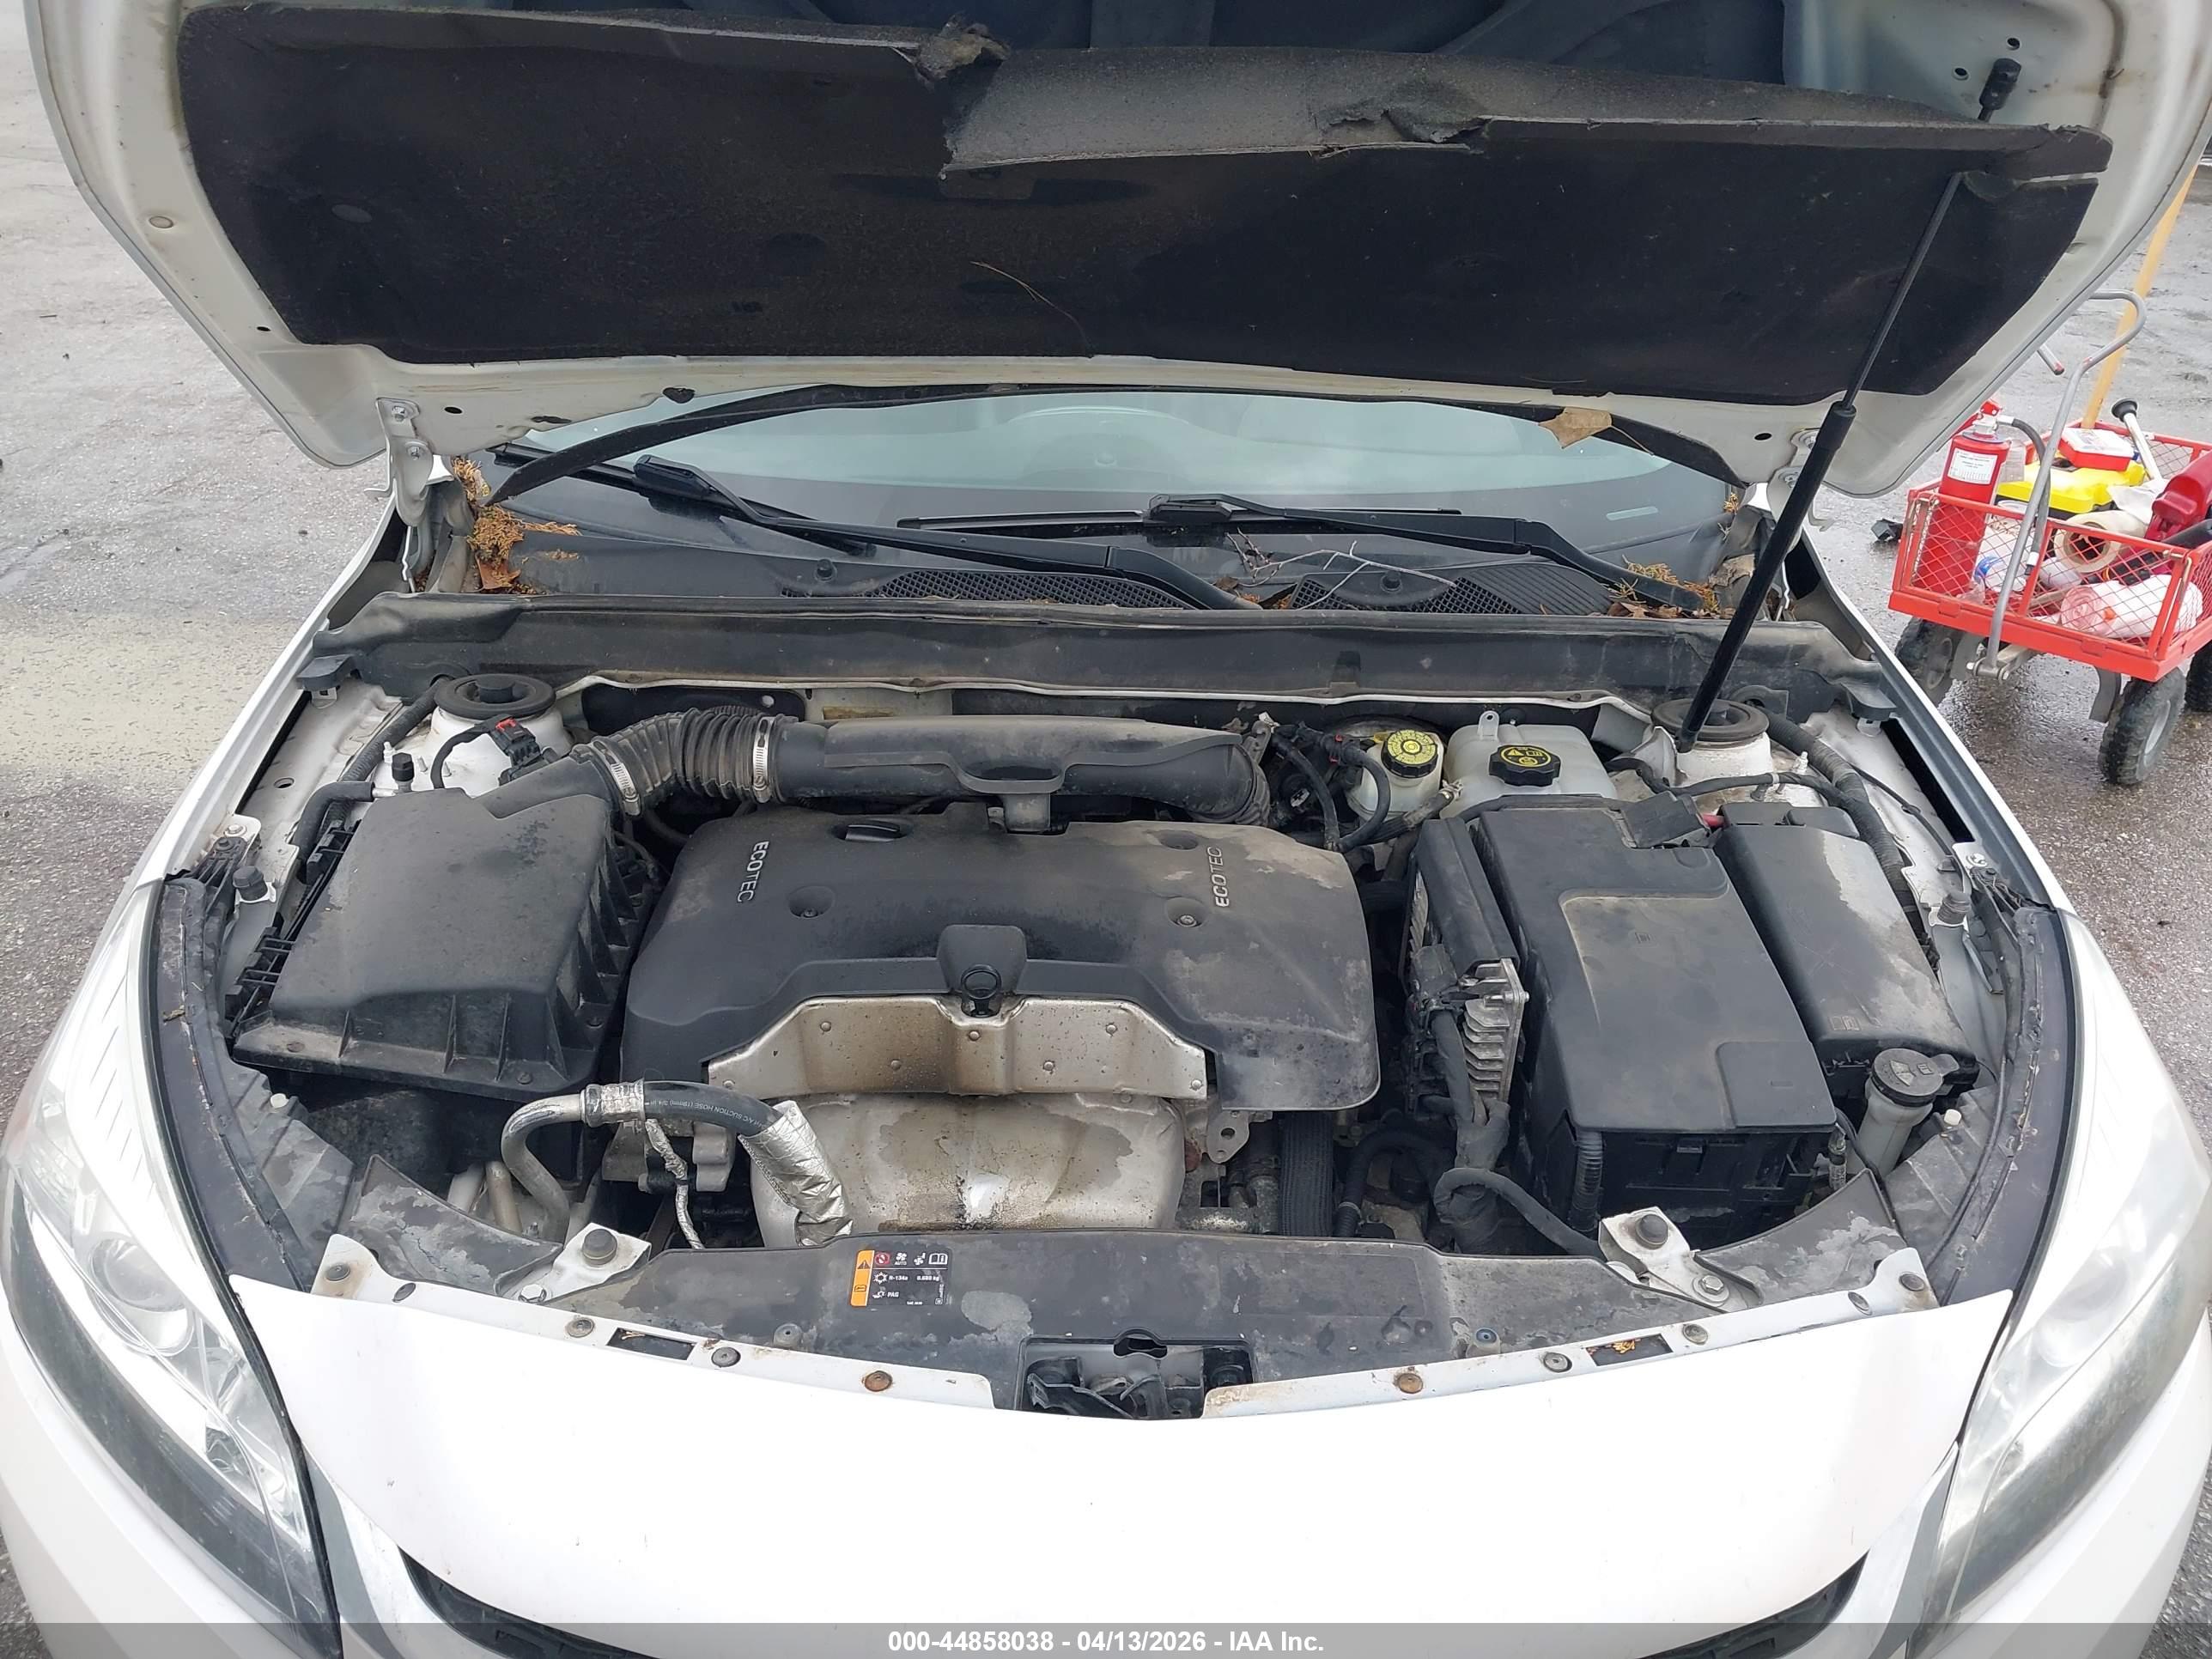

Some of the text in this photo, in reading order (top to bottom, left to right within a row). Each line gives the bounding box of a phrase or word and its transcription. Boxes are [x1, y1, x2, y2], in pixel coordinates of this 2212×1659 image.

[737, 841, 769, 902] ECOTEC
[1206, 846, 1230, 908] ECOTEC
[694, 1103, 714, 1111] HOSE
[714, 1106, 743, 1121] SUCTION
